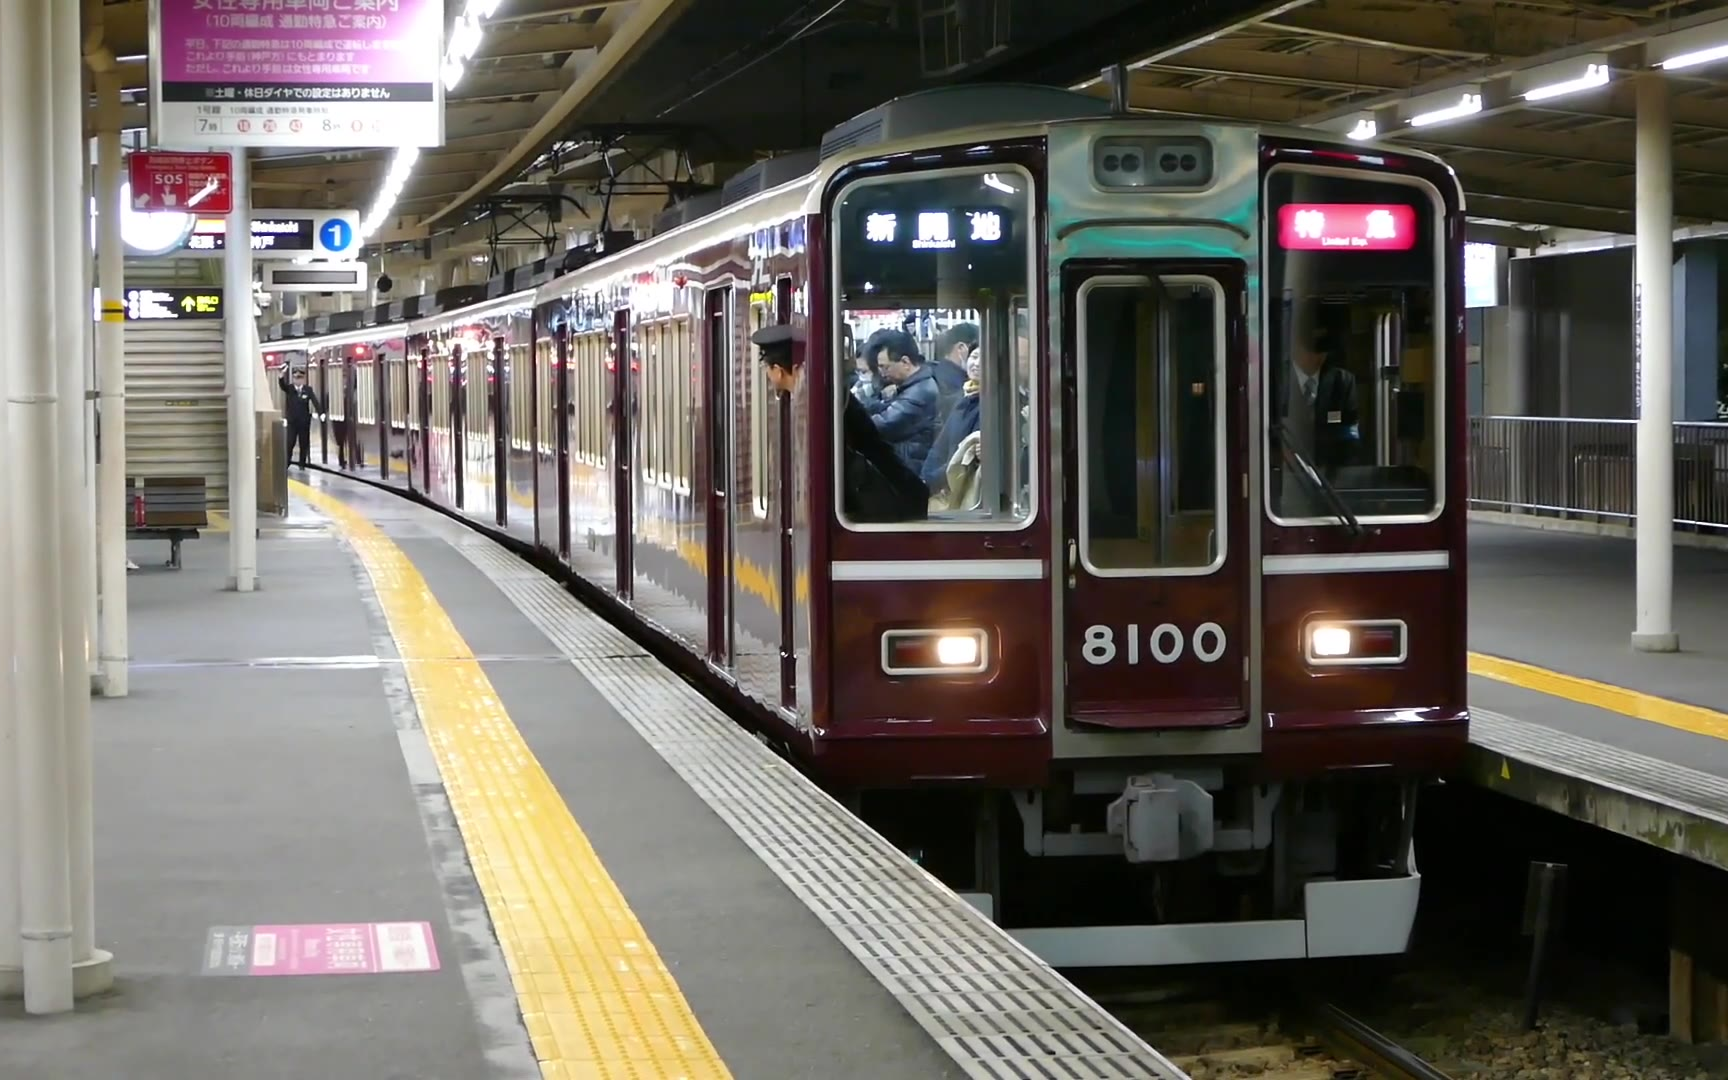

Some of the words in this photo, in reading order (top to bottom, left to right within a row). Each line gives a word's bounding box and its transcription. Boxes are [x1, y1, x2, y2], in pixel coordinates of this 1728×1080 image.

[154, 174, 183, 184] SOS
[328, 225, 342, 247] 1
[1294, 209, 1396, 239] 特急
[1082, 622, 1227, 665] 8100
